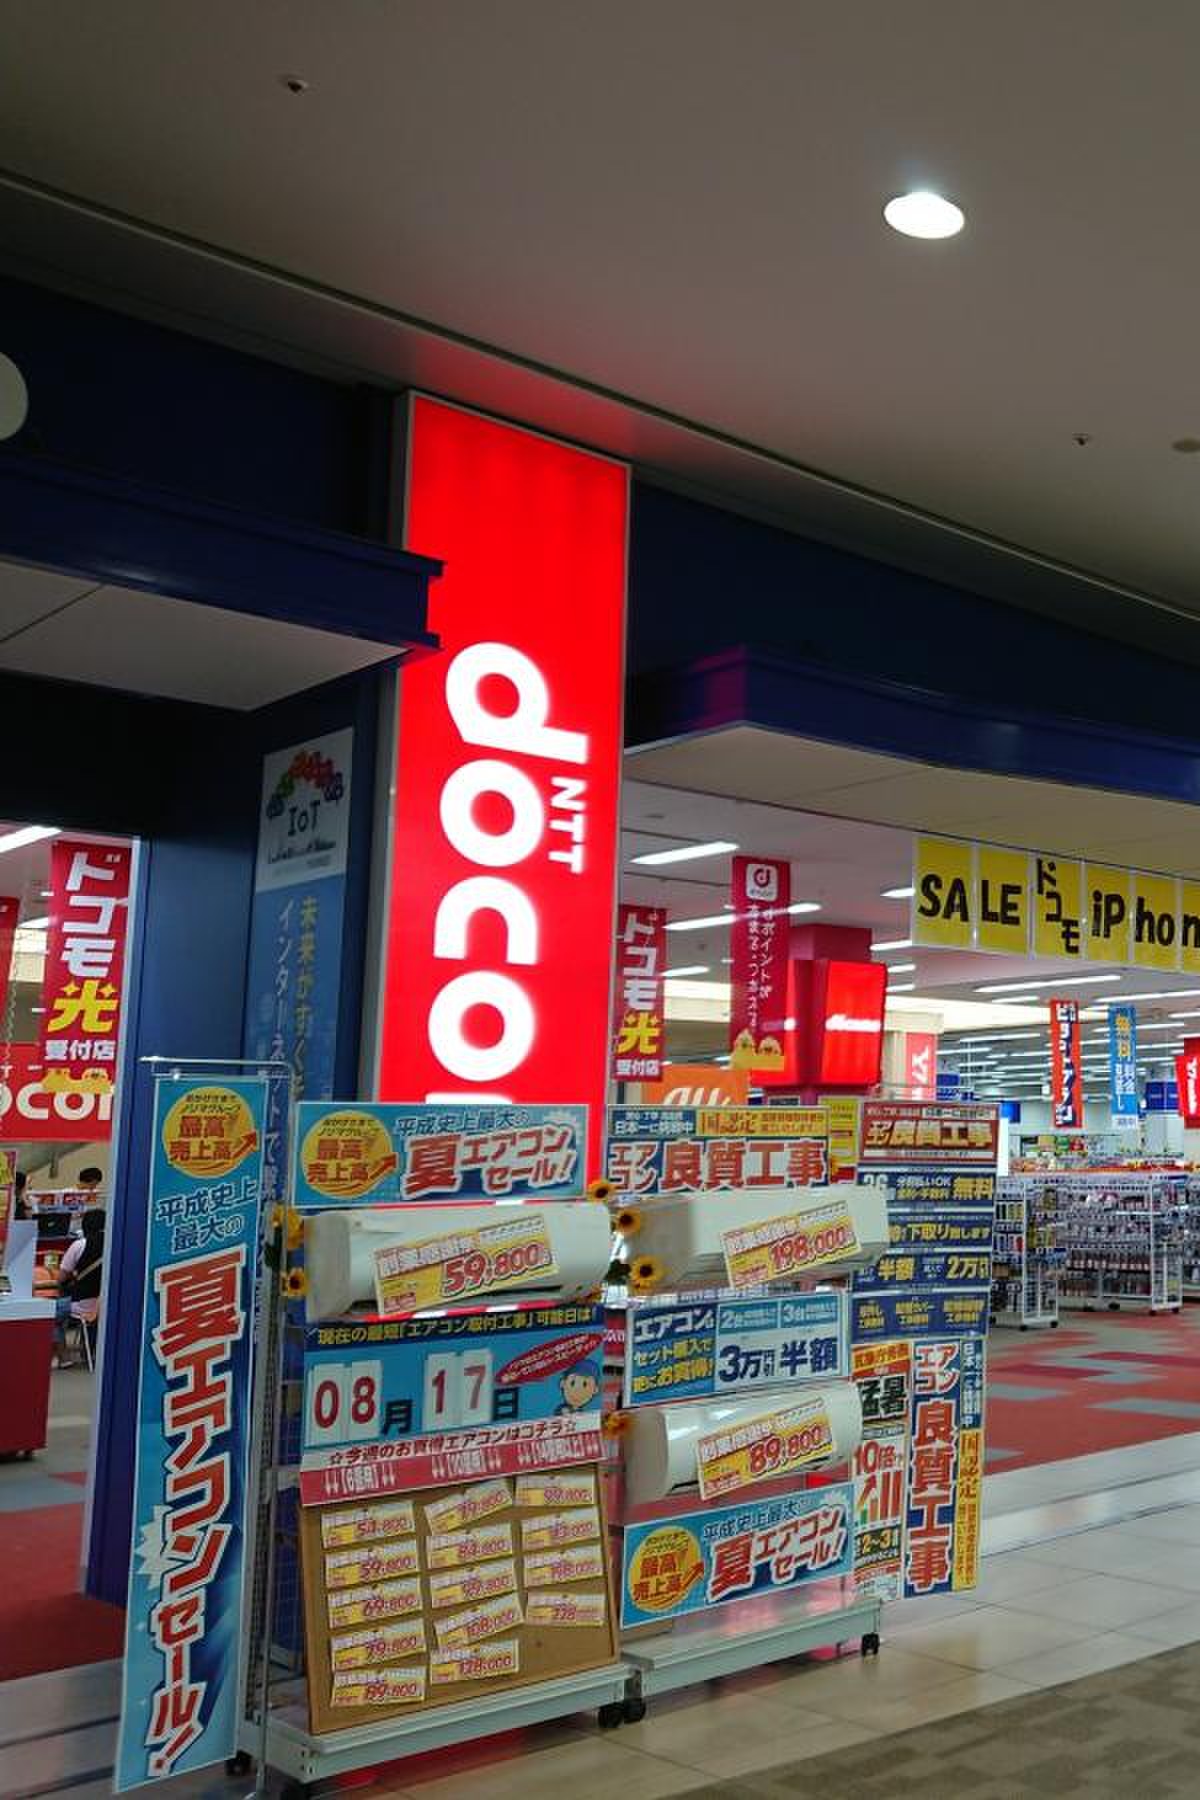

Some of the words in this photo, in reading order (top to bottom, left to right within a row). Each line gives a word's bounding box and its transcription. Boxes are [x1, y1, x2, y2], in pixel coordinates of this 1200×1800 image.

[548, 776, 587, 874] NTT
[425, 642, 588, 1104] doco
[917, 872, 1023, 926] SALE
[1036, 857, 1080, 954] ドコモ
[48, 850, 122, 1034] ドコモ光
[617, 911, 661, 1055] ドコモ光
[44, 1038, 117, 1061] 受付店
[404, 1133, 462, 1195] 夏
[156, 1176, 258, 1227] 平成史上
[313, 1375, 377, 1429] 08
[382, 1398, 413, 1436] 月
[431, 1364, 487, 1415] 17
[493, 1386, 519, 1420] 日
[710, 1533, 754, 1597] 夏
